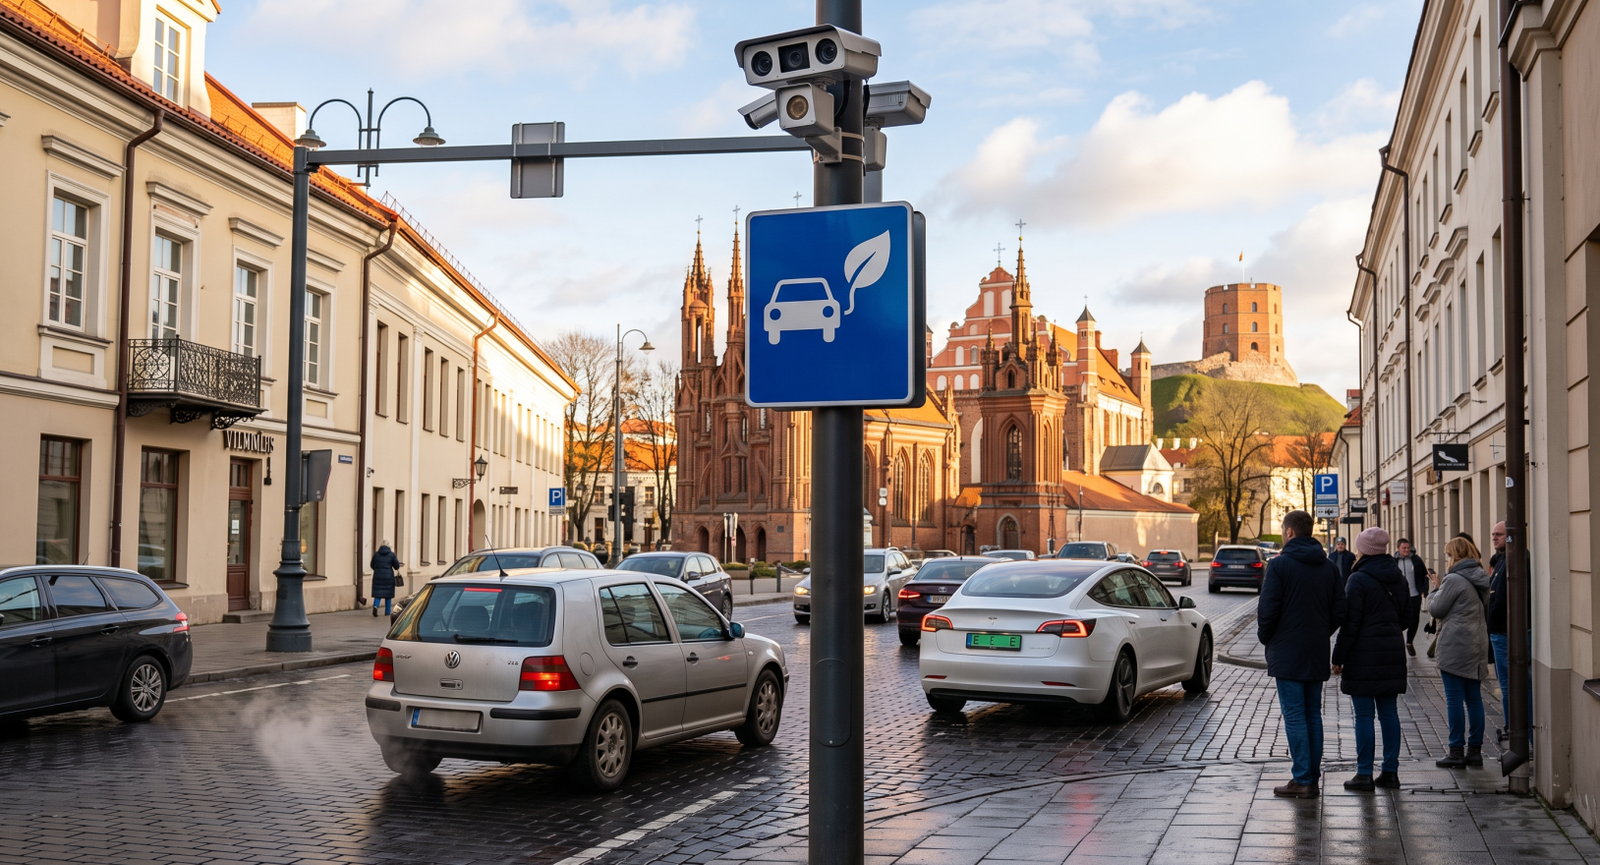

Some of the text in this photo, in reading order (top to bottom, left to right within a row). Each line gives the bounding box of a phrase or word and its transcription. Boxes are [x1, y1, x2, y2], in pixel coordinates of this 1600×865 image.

[1321, 476, 1333, 493] P
[552, 490, 561, 503] P
[973, 635, 979, 645] E
[1010, 636, 1016, 647] E
